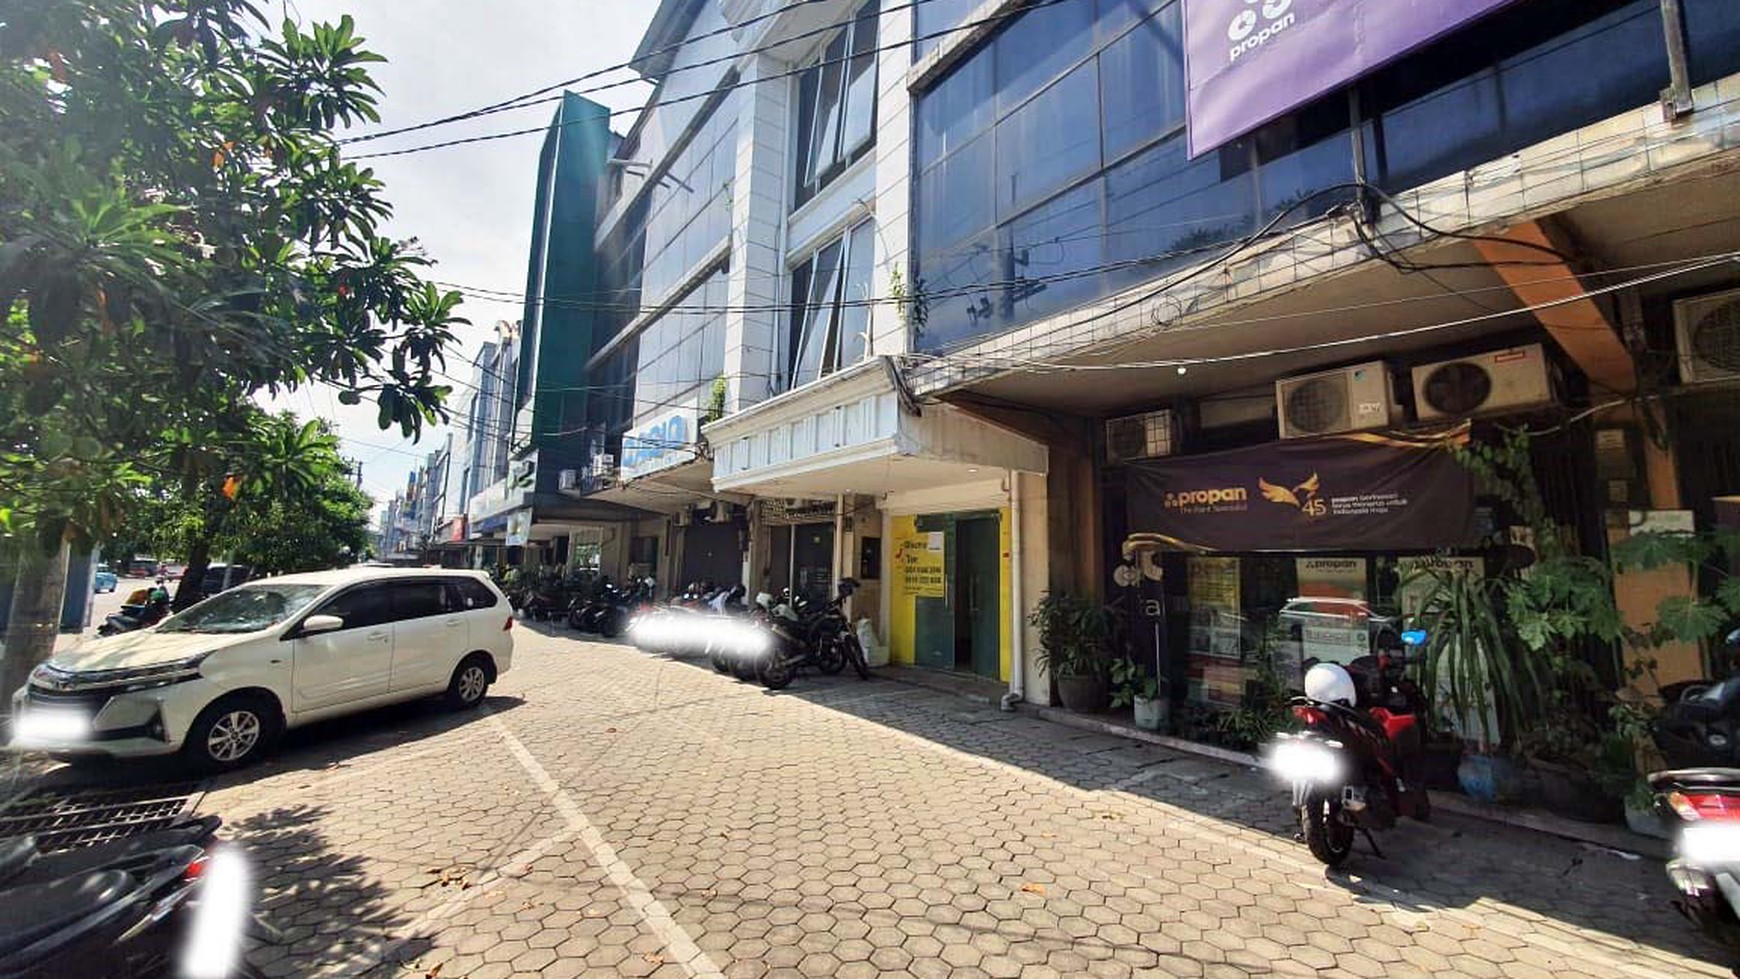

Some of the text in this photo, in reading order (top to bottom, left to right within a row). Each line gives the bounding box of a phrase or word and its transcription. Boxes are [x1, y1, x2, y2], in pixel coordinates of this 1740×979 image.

[1230, 13, 1295, 61] propan
[1178, 487, 1247, 507] propan
[1301, 498, 1327, 517] 45
